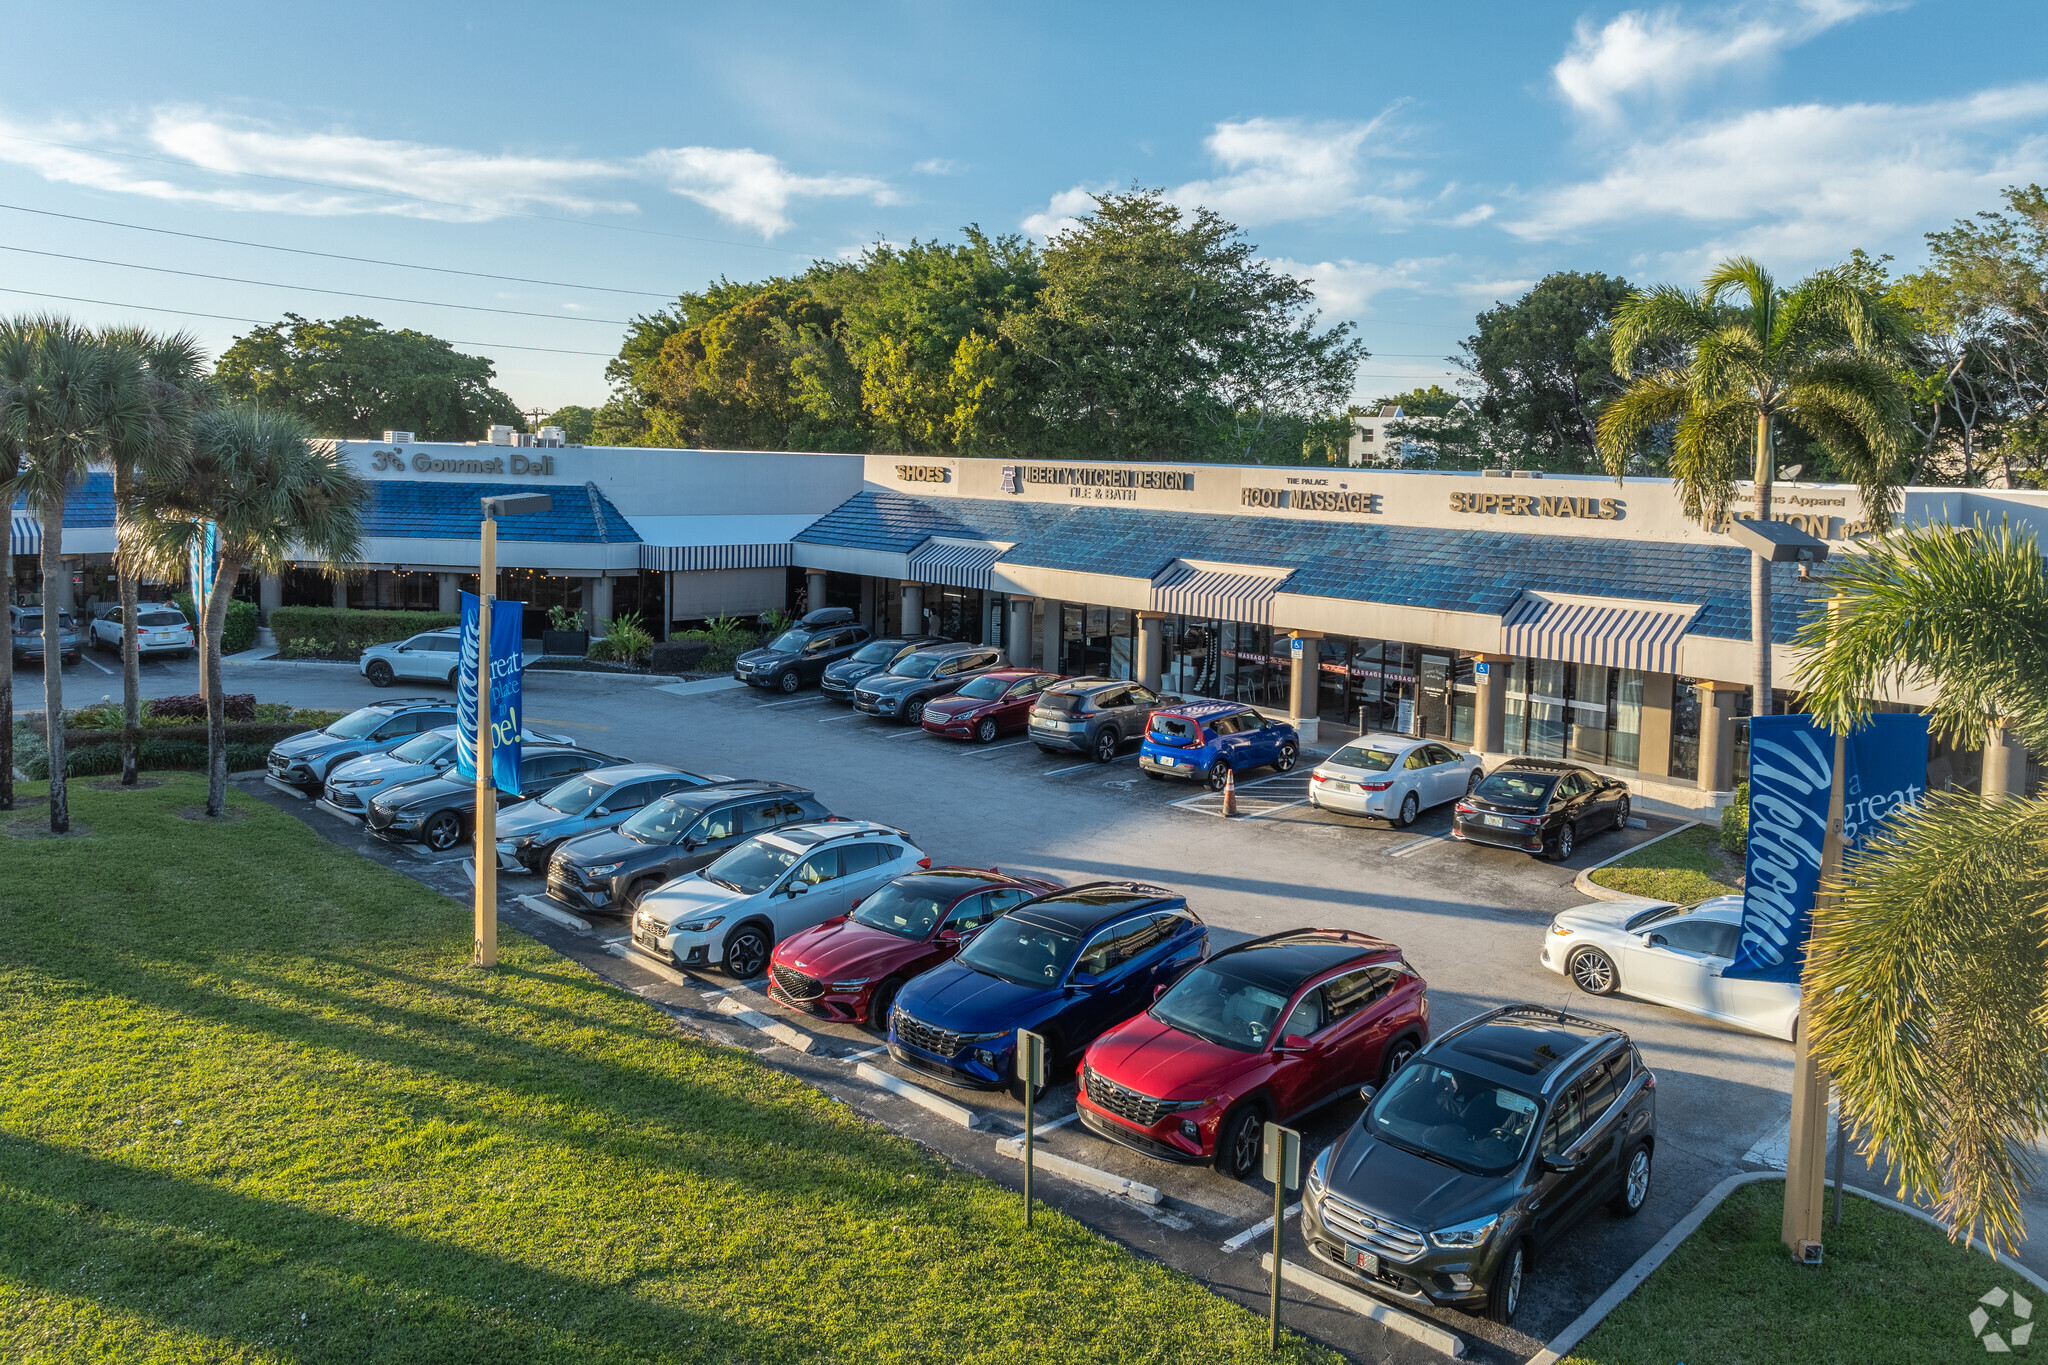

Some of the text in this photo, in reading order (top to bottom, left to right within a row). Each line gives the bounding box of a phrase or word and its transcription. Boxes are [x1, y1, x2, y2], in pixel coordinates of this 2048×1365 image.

[412, 453, 503, 474] Gourmet
[510, 454, 554, 475] Deli
[896, 465, 945, 482] SHOES
[1021, 466, 1185, 490] LIBERTY KITCHEN DESIGN
[1286, 477, 1328, 486] THE PALACE
[1068, 487, 1137, 501] TILE & BATH
[1240, 487, 1373, 514] FOOT MASSAGE
[1788, 494, 1845, 507] Apparel
[1449, 491, 1617, 520] SUPER NAILS
[1703, 508, 1830, 540] FAON
[489, 651, 521, 685] reat
[1238, 652, 1265, 662] MASSAGE
[1351, 668, 1382, 678] MASSAGE
[1384, 673, 1416, 683] MASSAGE
[491, 679, 520, 703] place
[499, 703, 507, 716] to
[1844, 782, 1923, 842] great
[1740, 729, 1832, 969] Welcome
[1357, 1252, 1365, 1268] B
